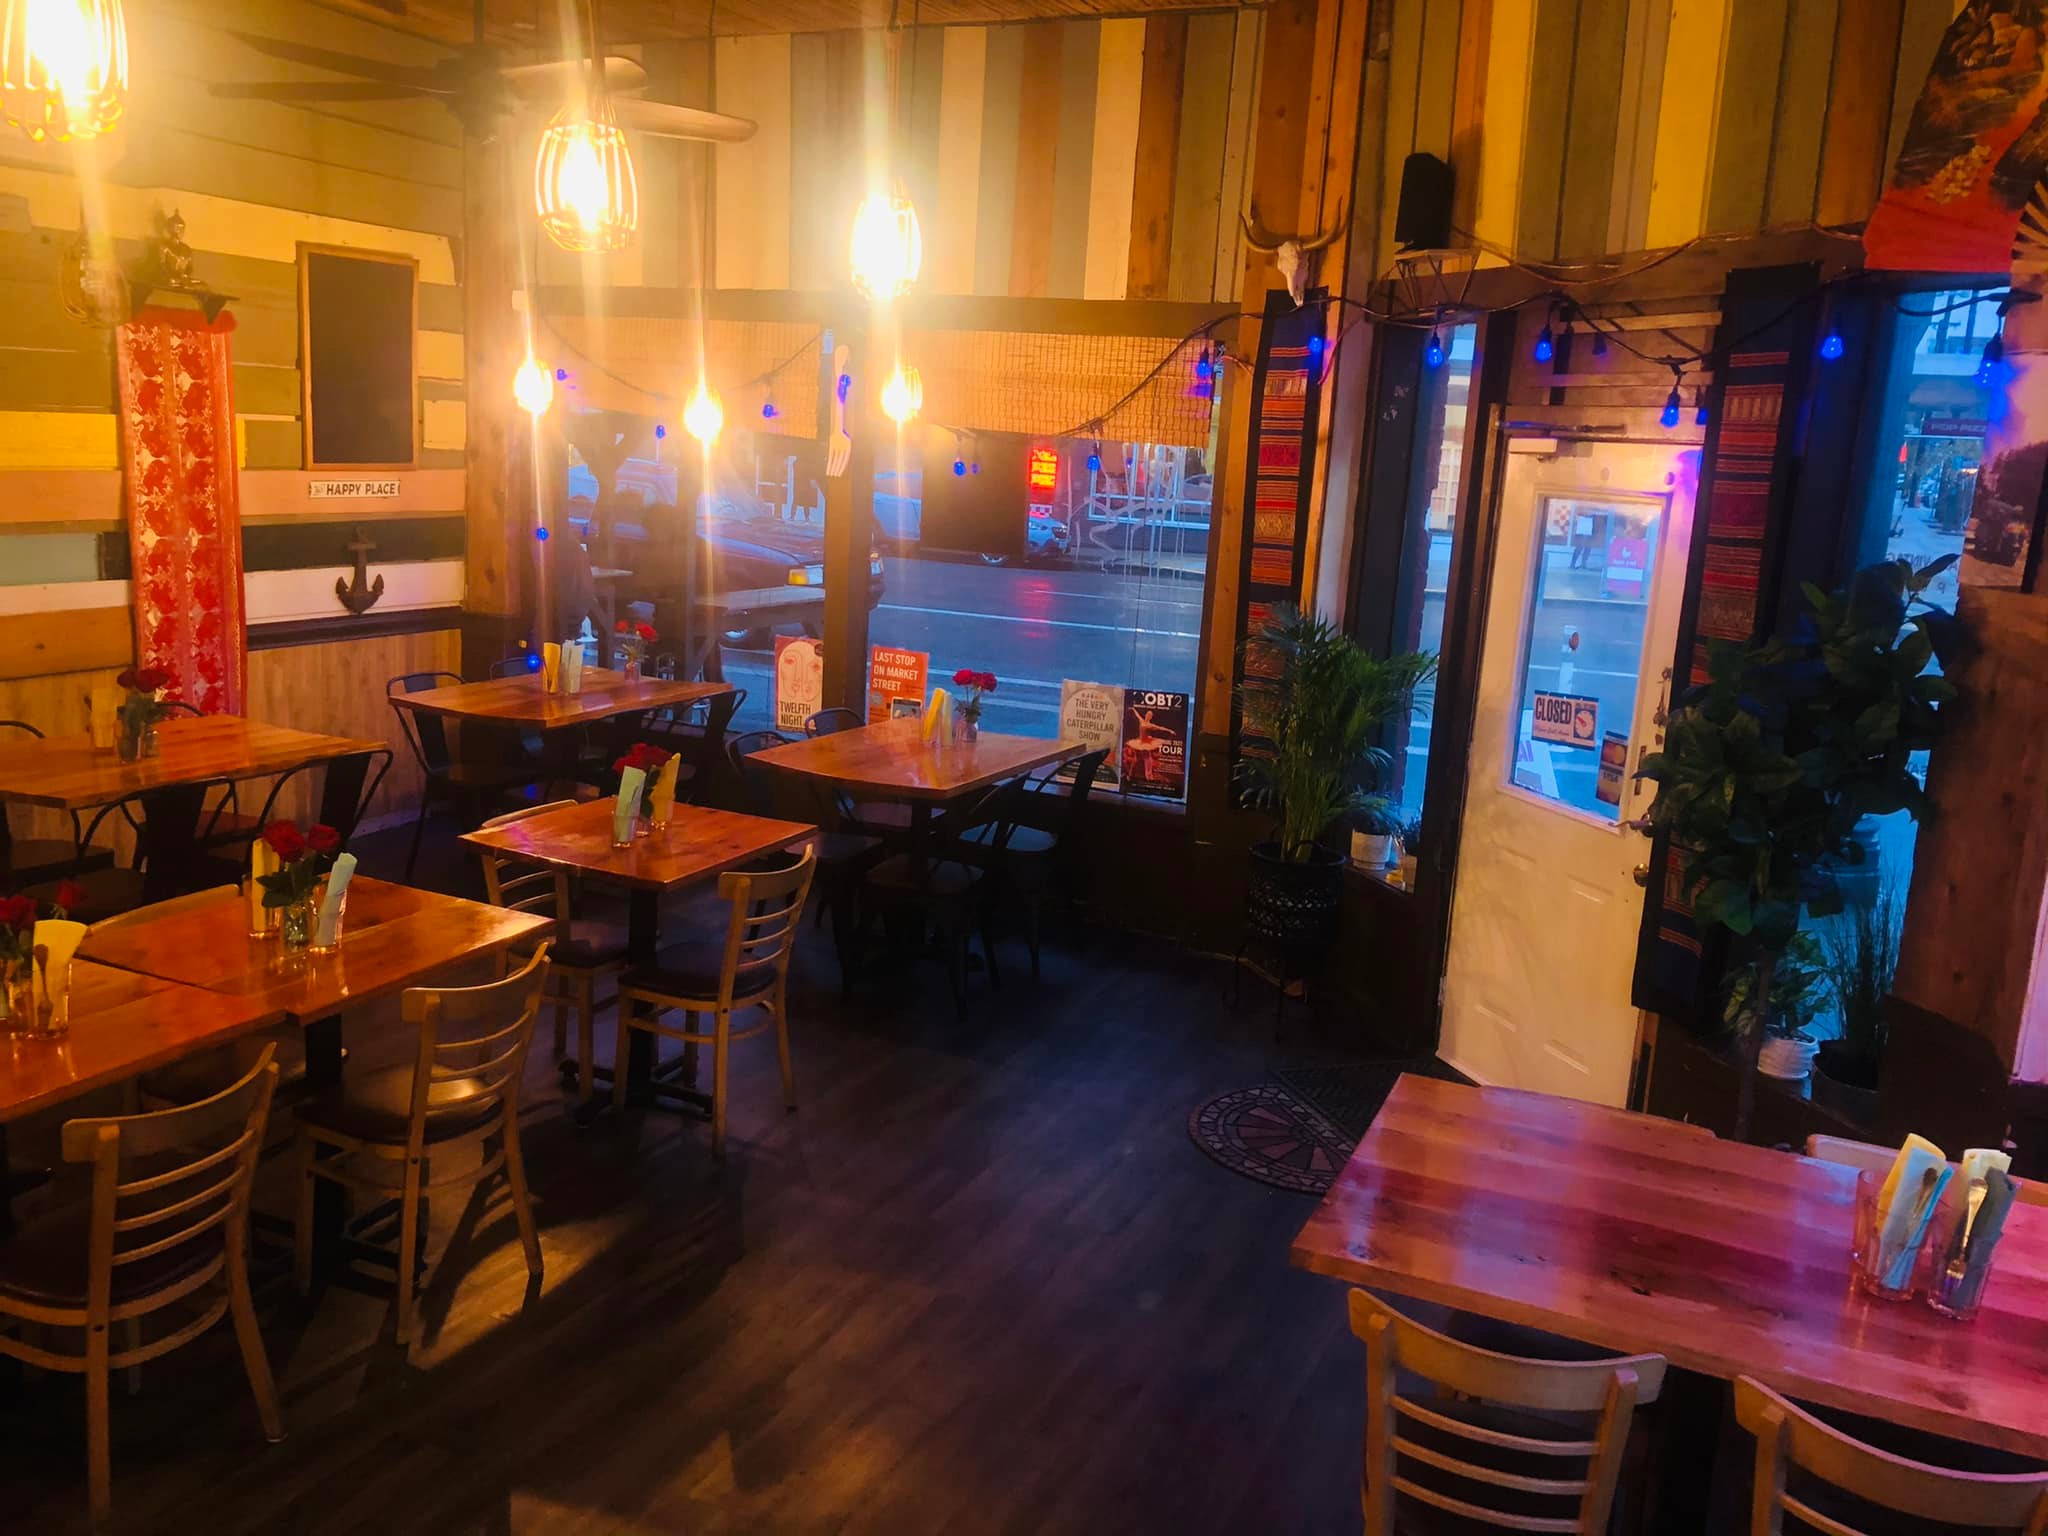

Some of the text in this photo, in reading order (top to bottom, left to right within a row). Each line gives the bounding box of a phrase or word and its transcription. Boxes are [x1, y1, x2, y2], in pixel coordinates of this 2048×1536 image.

[326, 483, 361, 495] HAPPY
[365, 483, 396, 494] PLACE
[874, 650, 916, 666] LAST STOP
[873, 664, 919, 680] ON MARKET
[872, 678, 901, 692] STREET
[780, 701, 812, 715] TWELFTH
[1075, 698, 1109, 710] THE VERY
[1535, 696, 1572, 725] CLOSED
[780, 713, 803, 727] NIGHT
[1076, 710, 1107, 720] HUNGRY
[1066, 718, 1115, 732] CATERPILLAR
[1078, 730, 1101, 741] SHOW
[1159, 744, 1183, 756] TOUR
